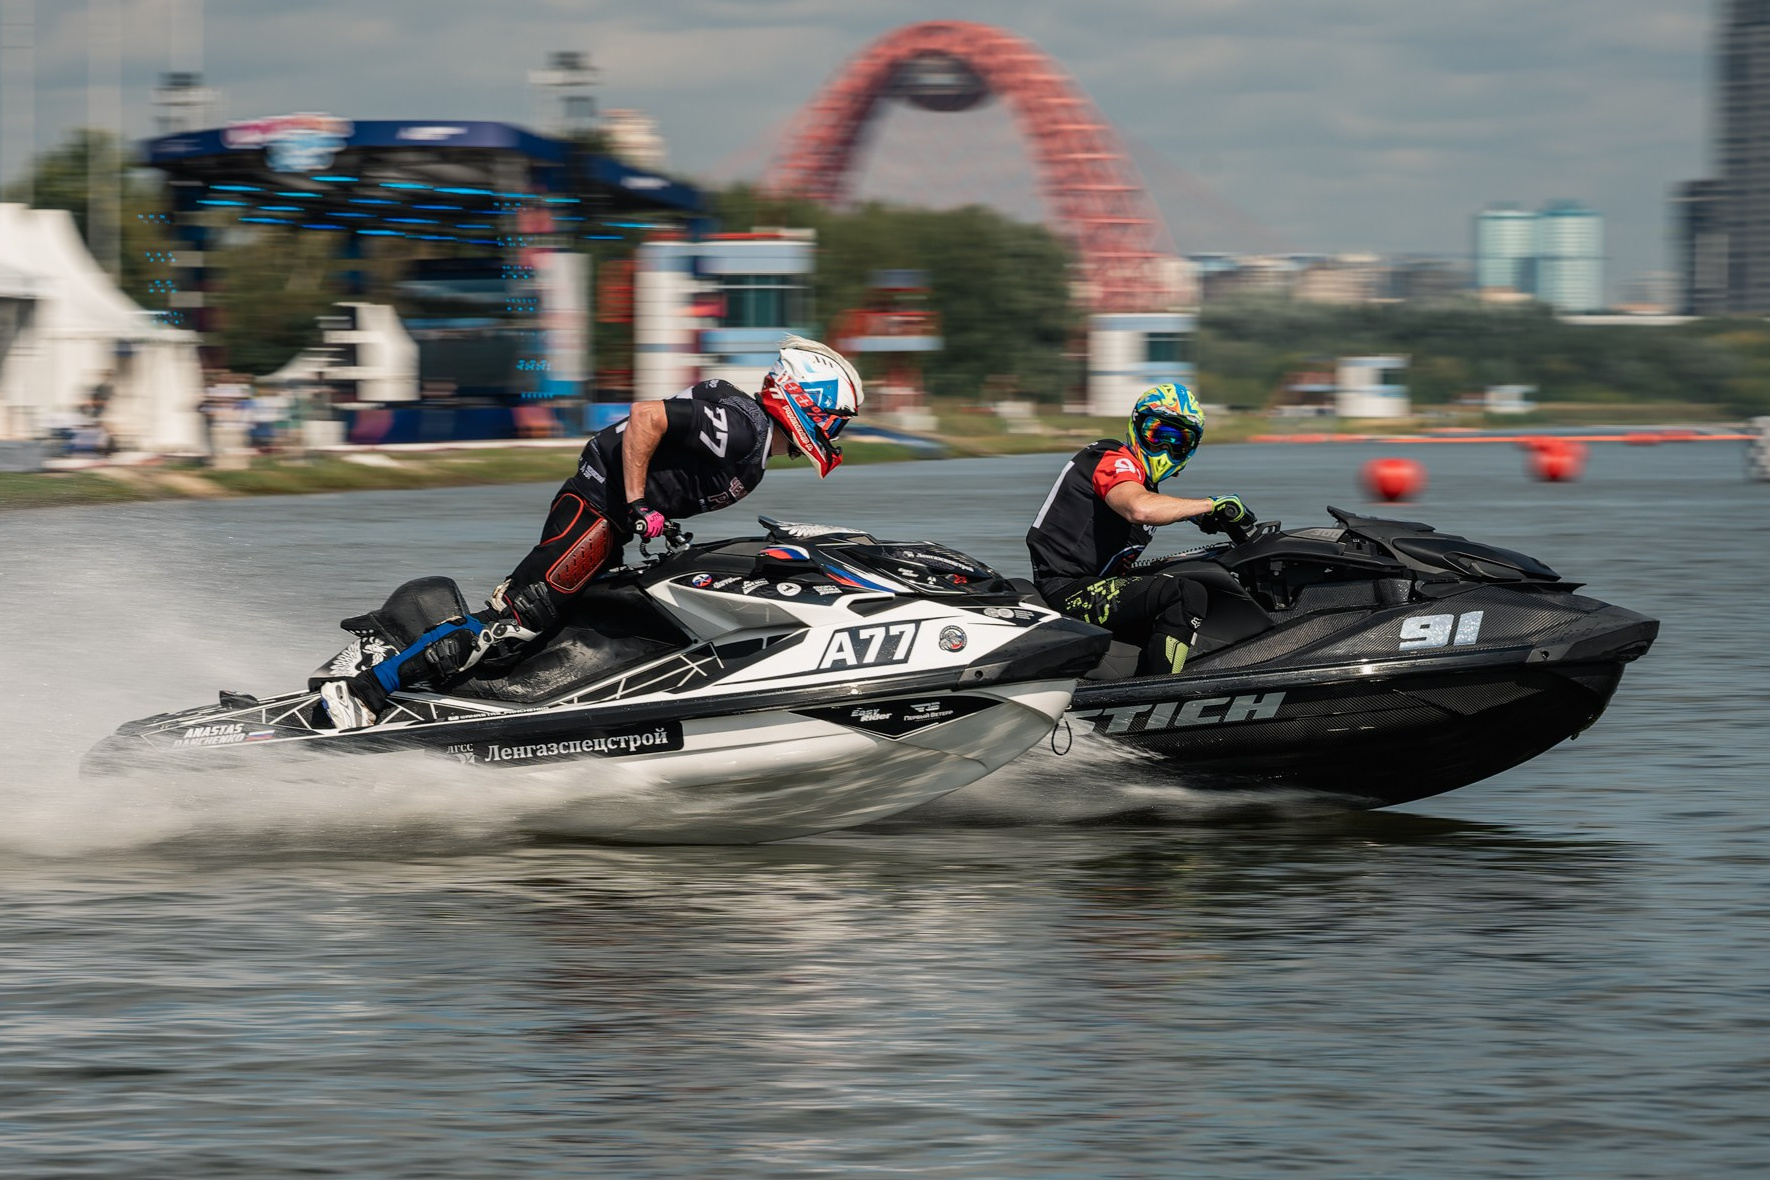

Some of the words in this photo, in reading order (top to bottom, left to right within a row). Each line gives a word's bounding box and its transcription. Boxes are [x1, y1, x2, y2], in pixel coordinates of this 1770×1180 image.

[699, 406, 728, 457] 77
[819, 622, 916, 670] A77
[1399, 610, 1484, 652] 91
[183, 723, 245, 739] ANASTAS
[860, 712, 893, 722] Rider
[484, 727, 669, 763] Ленгазспецстрой
